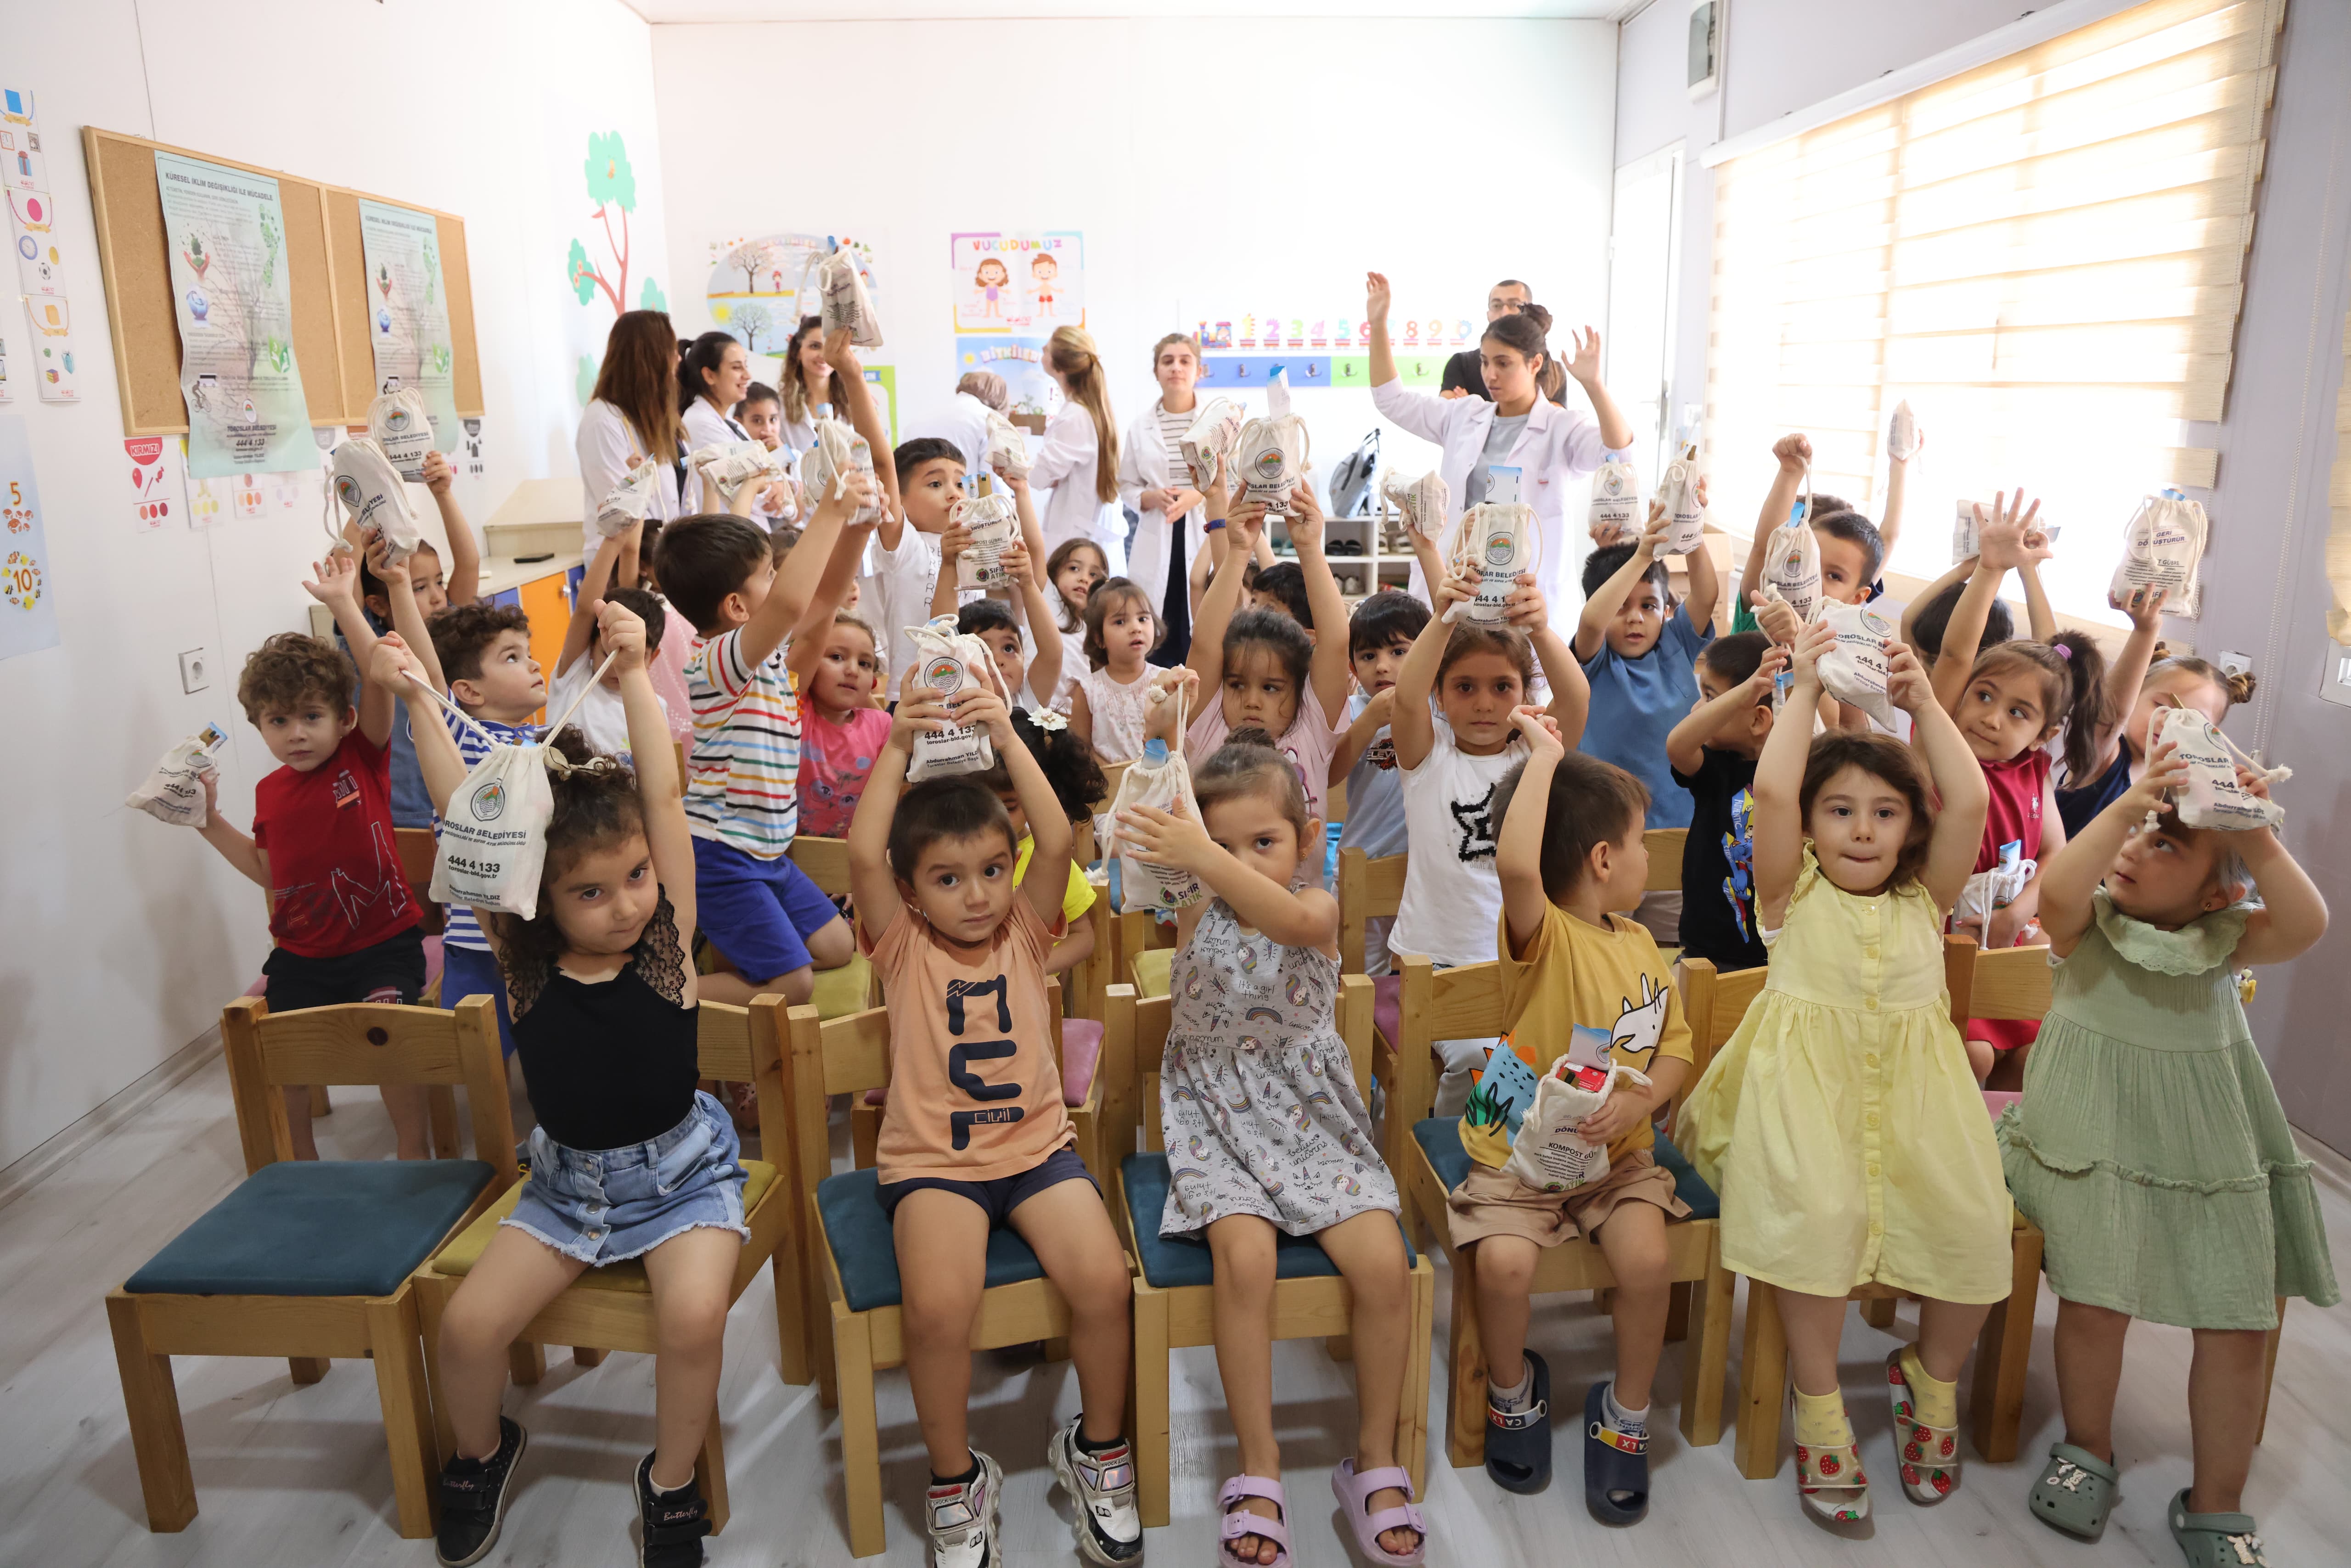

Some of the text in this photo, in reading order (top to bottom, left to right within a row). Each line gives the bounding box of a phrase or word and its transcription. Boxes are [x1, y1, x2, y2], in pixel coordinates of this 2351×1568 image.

[1266, 319, 1280, 338] 2
[1291, 319, 1303, 338] 3
[1310, 320, 1325, 337] 4
[1338, 318, 1350, 339] 5
[1360, 321, 1371, 338] 6
[1406, 320, 1418, 337] 8
[1428, 319, 1442, 337] 9
[130, 443, 159, 456] KIRMIZI
[10, 482, 22, 506] 5
[2137, 536, 2185, 546] DÖÜŞTÜRÜR
[13, 568, 33, 593] 10
[924, 731, 945, 739] 444
[927, 735, 973, 745] toroslar-bld.gov.
[926, 754, 964, 764] Abdurrahman
[1734, 799, 1744, 830] AUTHENTIC
[444, 820, 527, 839] ROSLAR BELEDİYESİ
[448, 855, 500, 873] 444 4 133
[449, 865, 497, 878] toroslar-bld.gov.tr
[1238, 980, 1250, 989] It's
[1260, 984, 1275, 994] girl
[1242, 991, 1269, 1001] thing
[1288, 1021, 1314, 1033] unicorn
[1287, 1138, 1317, 1157] believe
[1289, 1141, 1327, 1166] unicorns
[1548, 1142, 1584, 1158] KOMPOST
[443, 1479, 474, 1490] Butterfly
[933, 1498, 948, 1506] SHOCK
[664, 1506, 698, 1521] Butterfly
